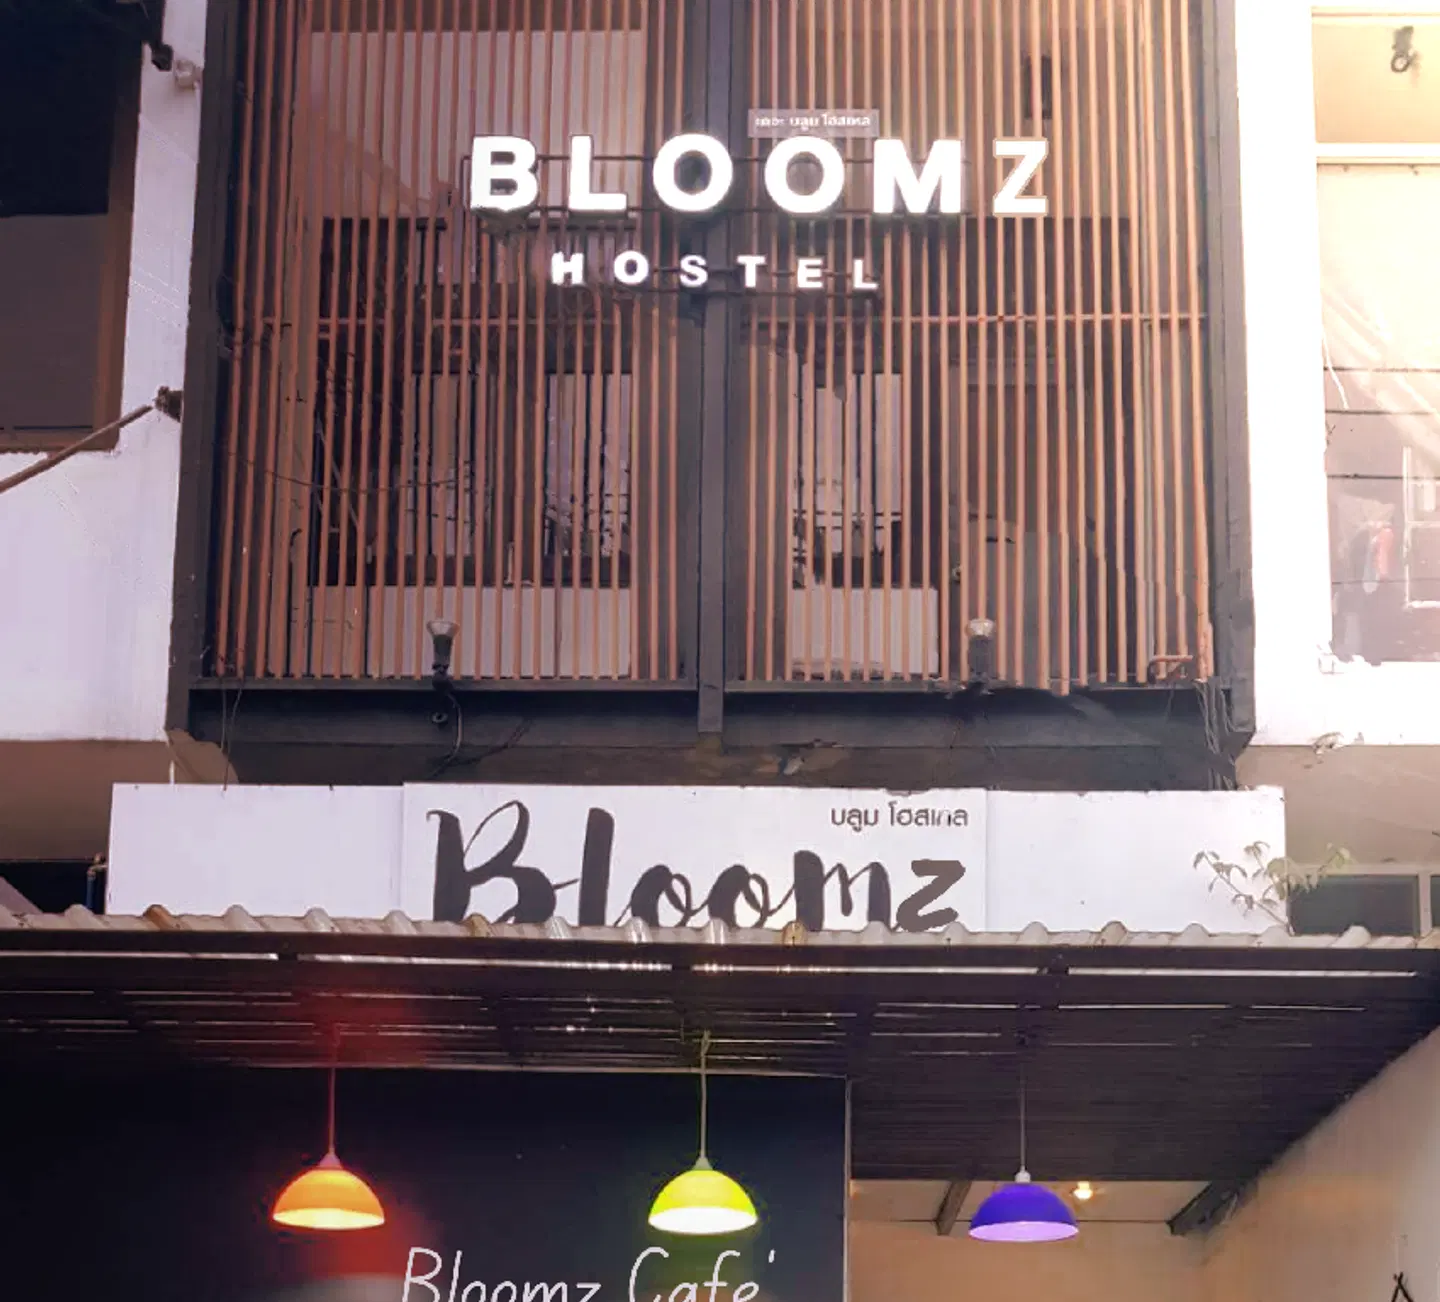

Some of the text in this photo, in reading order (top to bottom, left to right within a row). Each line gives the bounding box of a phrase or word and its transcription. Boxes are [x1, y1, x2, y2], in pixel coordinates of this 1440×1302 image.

[469, 132, 1049, 218] BLOOMZ
[550, 249, 879, 290] HOSTEL
[830, 807, 879, 832] บลูม
[425, 800, 967, 932] Bloomz
